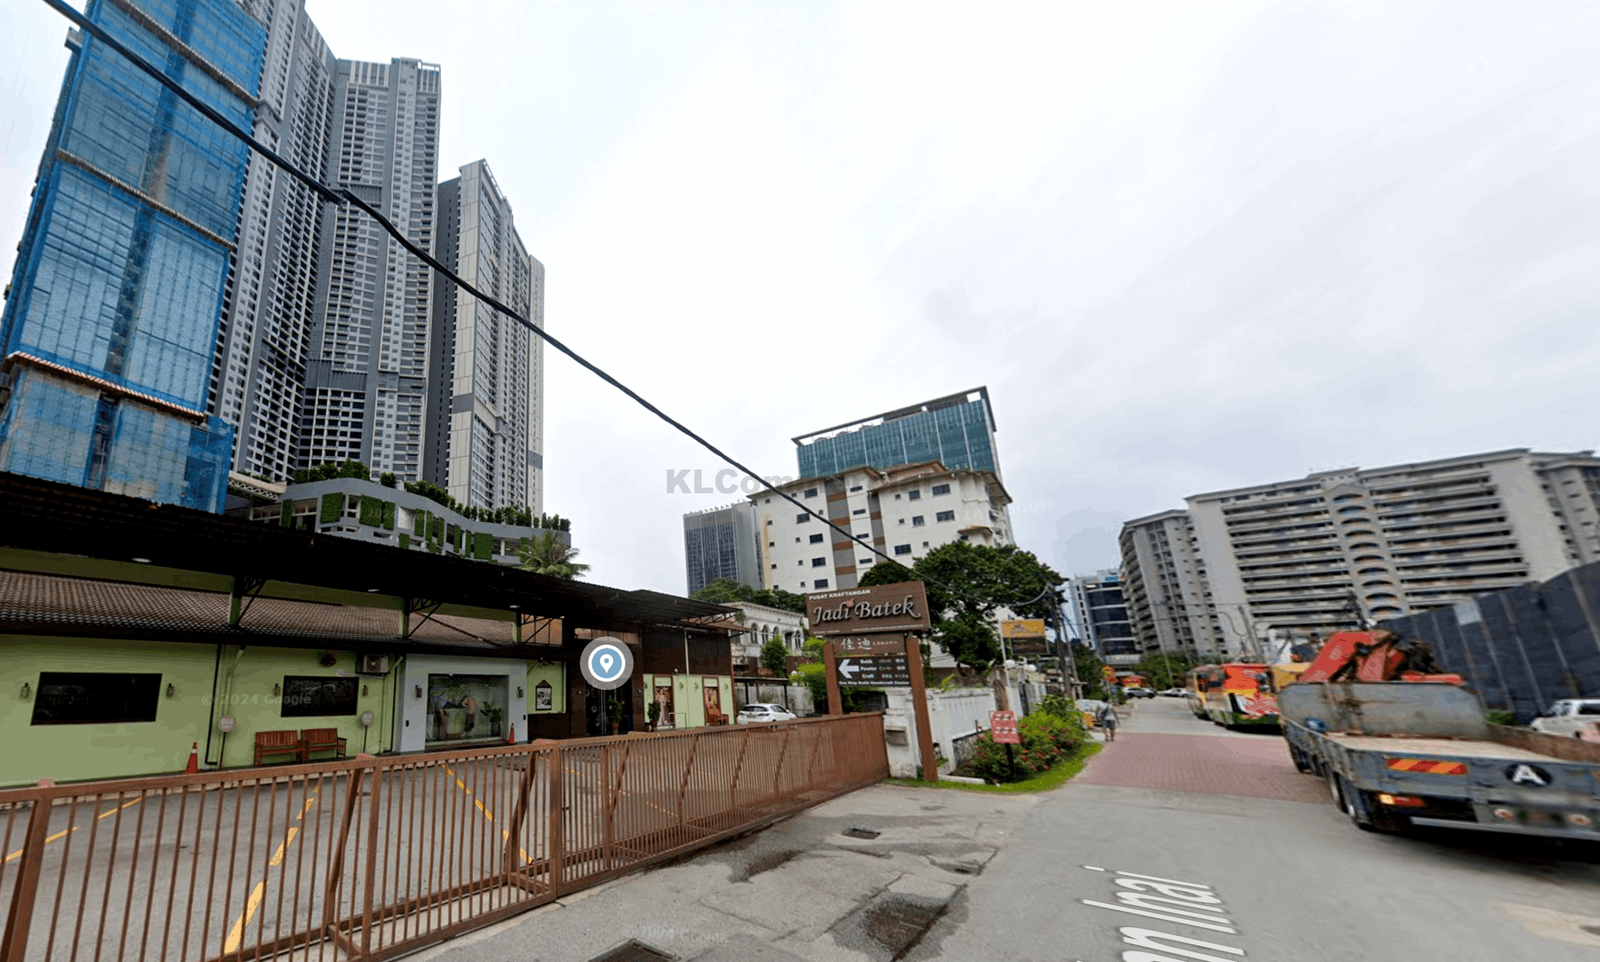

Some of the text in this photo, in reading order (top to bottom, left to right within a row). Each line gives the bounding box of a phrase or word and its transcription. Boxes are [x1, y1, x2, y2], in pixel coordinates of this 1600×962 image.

[829, 589, 871, 598] KRAFTANGAN
[811, 595, 922, 625] Jadi Batek
[1512, 764, 1546, 786] A
